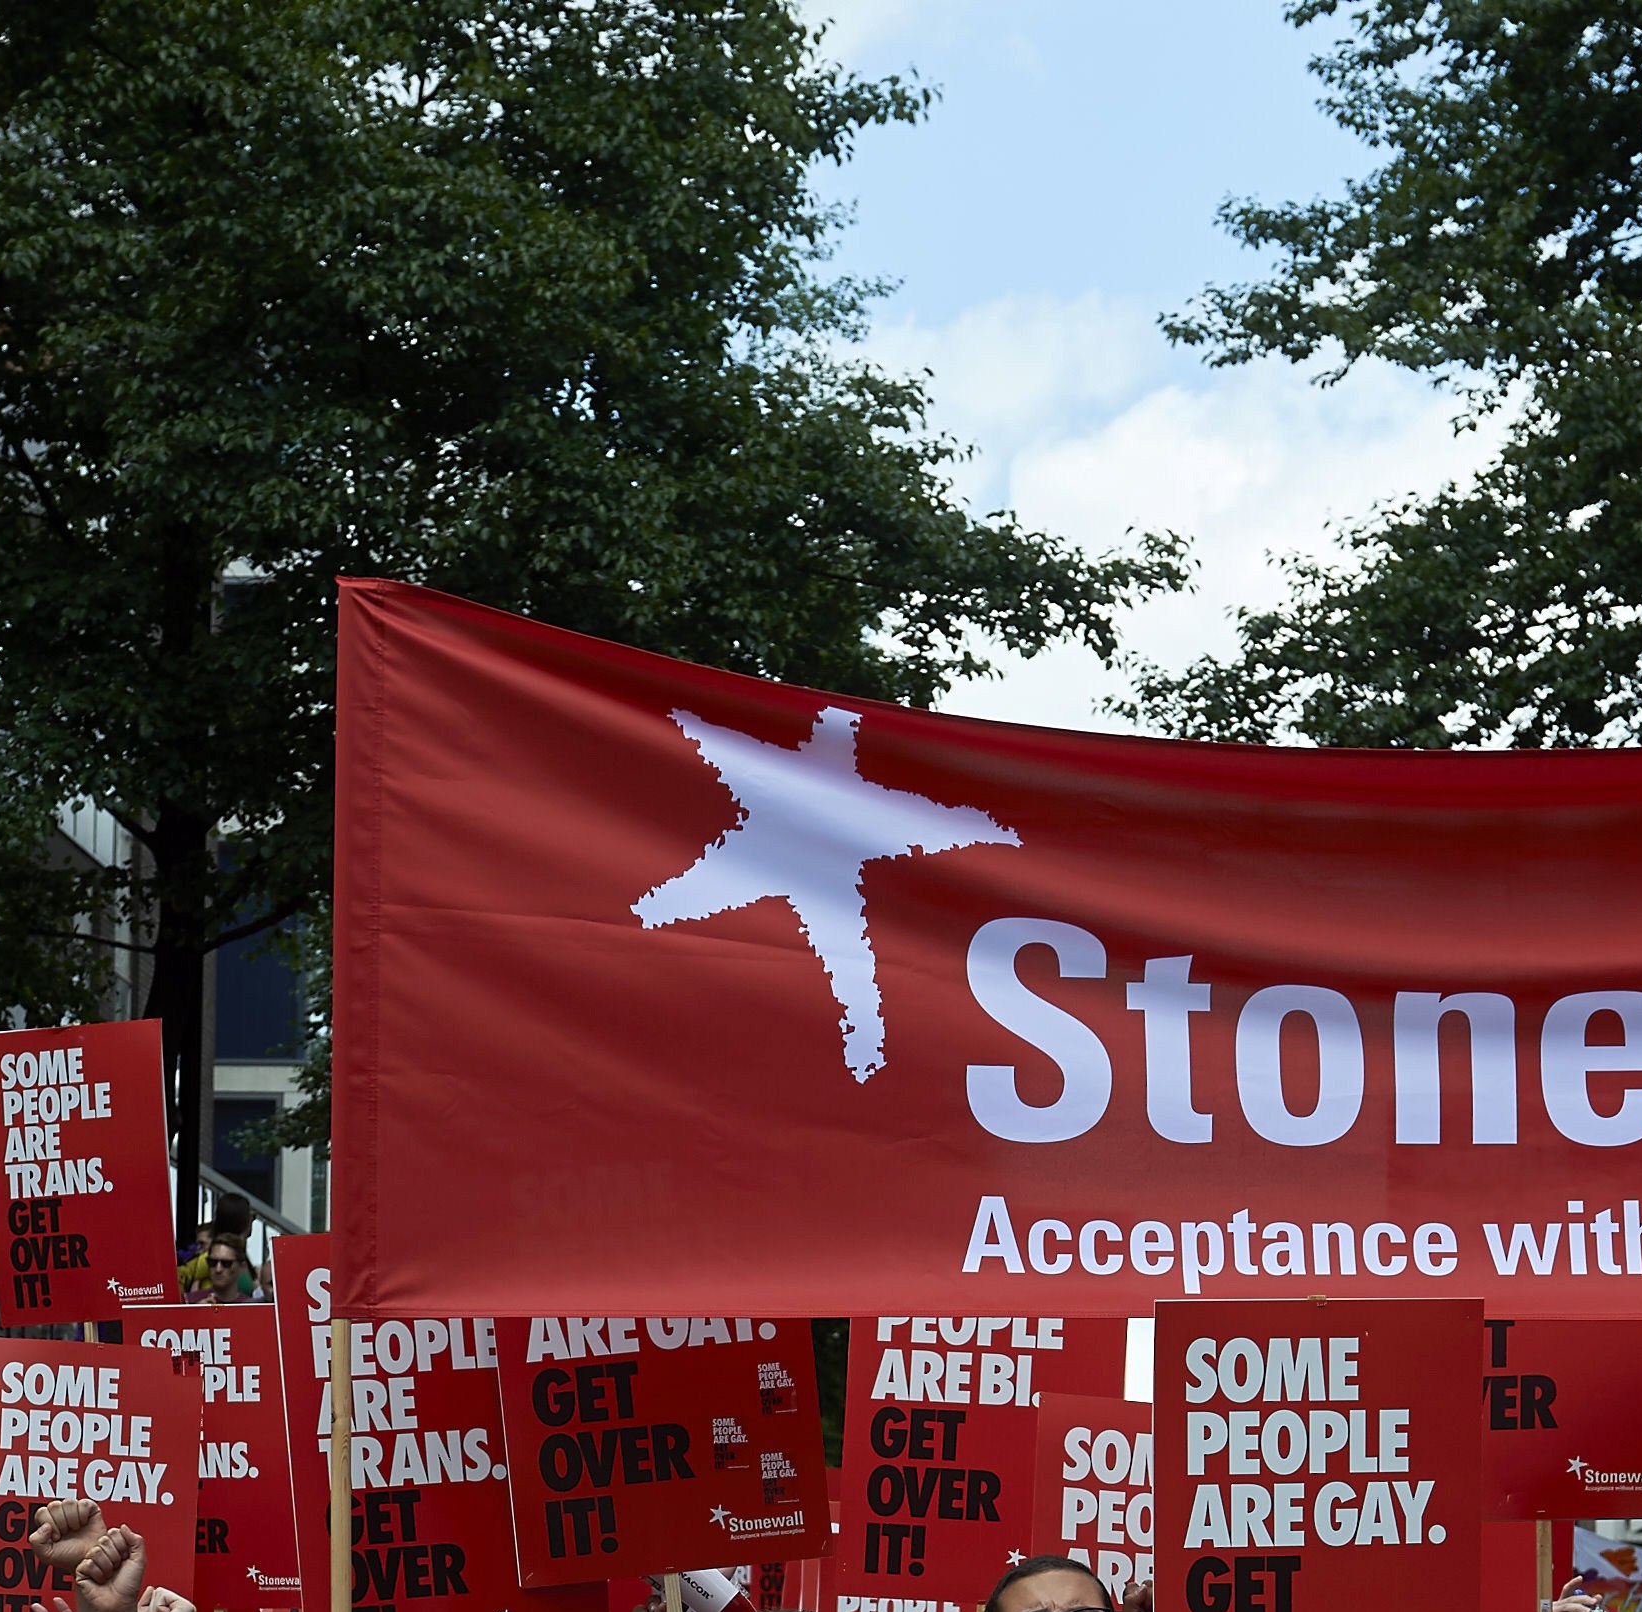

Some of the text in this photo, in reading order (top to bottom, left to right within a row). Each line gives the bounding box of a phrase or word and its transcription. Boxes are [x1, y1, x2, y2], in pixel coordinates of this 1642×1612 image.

[0, 1047, 83, 1089] SOME
[3, 1082, 111, 1127] PEOPLE
[4, 1124, 62, 1162] ARE
[5, 1157, 113, 1199] TRANS.
[8, 1198, 63, 1236] GET
[11, 1234, 91, 1272] OVER
[962, 1196, 1458, 1295] Acceptance
[14, 1273, 51, 1309] IT!
[118, 1283, 164, 1297] Stonewall
[1, 1362, 120, 1409] SOME
[532, 1361, 639, 1427] GET
[871, 1348, 1041, 1408] ARE BI.
[1185, 1337, 1360, 1404] SOME
[0, 1408, 152, 1457] PEOPLE
[712, 1417, 736, 1427] SOME
[713, 1426, 742, 1436] PEOPLE
[870, 1407, 967, 1461] GET
[1186, 1408, 1410, 1475] PEOPLE
[538, 1423, 696, 1493] OVER
[84, 1460, 173, 1505] GAY.
[866, 1464, 1003, 1522] OVER
[545, 1496, 619, 1558] IT!
[728, 1511, 804, 1533] Stonewall
[1184, 1480, 1446, 1549] ARE GAY.
[864, 1523, 926, 1578] IT!
